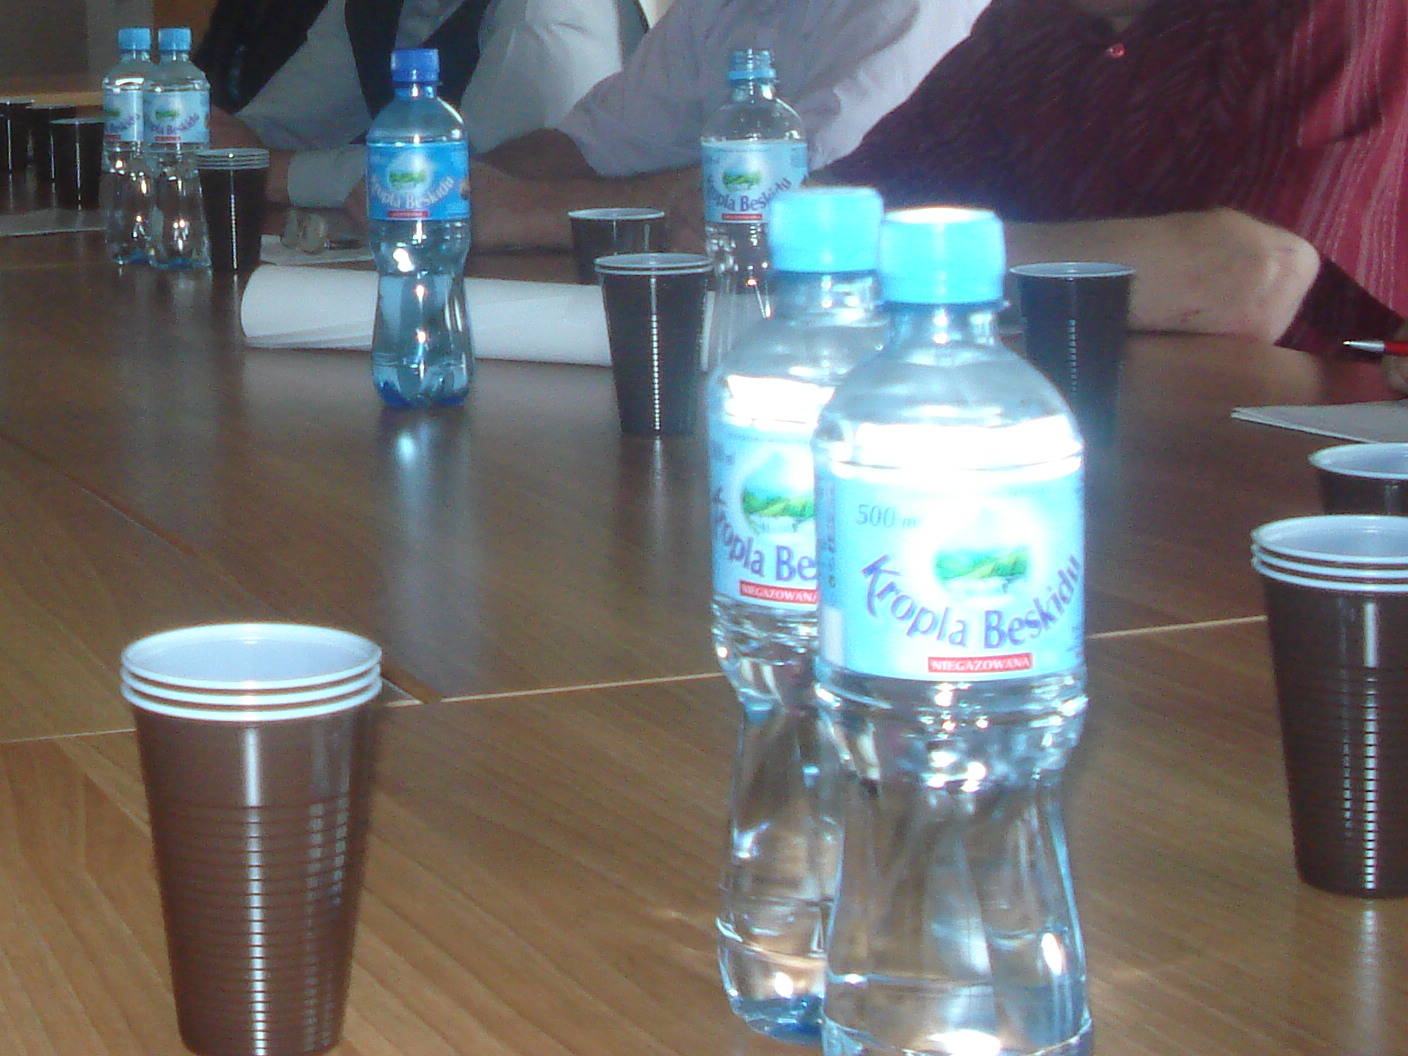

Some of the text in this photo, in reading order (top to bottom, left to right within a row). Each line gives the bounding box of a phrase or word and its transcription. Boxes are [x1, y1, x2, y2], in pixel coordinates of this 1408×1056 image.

[855, 503, 896, 528] 500
[861, 554, 969, 649] Kropla
[983, 554, 1082, 650] Beskidu
[930, 655, 1031, 672] NIEGAZOWANA
